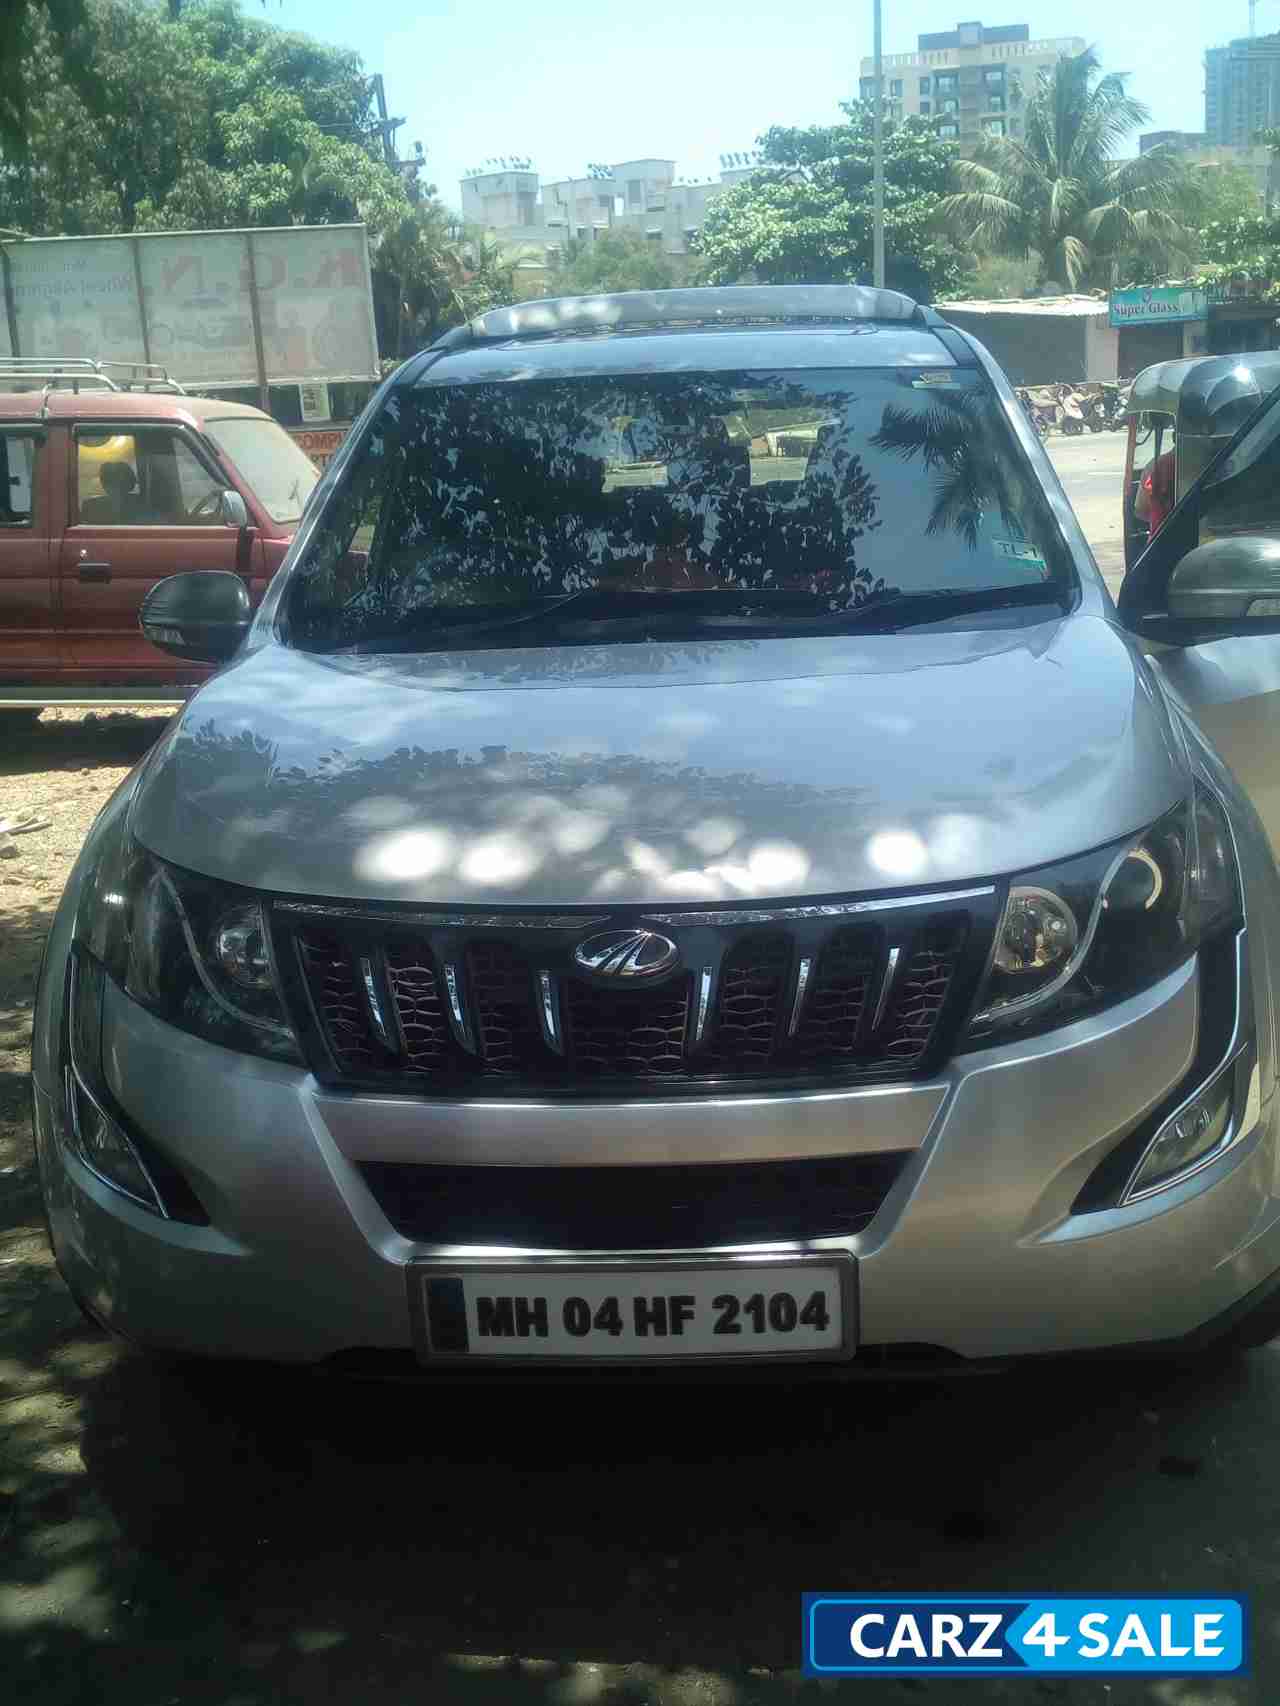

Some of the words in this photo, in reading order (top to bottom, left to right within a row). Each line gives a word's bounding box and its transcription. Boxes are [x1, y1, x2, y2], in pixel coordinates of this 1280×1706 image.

[1112, 302, 1147, 318] Super
[476, 1296, 549, 1337] MH
[562, 1296, 623, 1337] 04
[633, 1295, 696, 1336] HF
[711, 1291, 830, 1334] 2104
